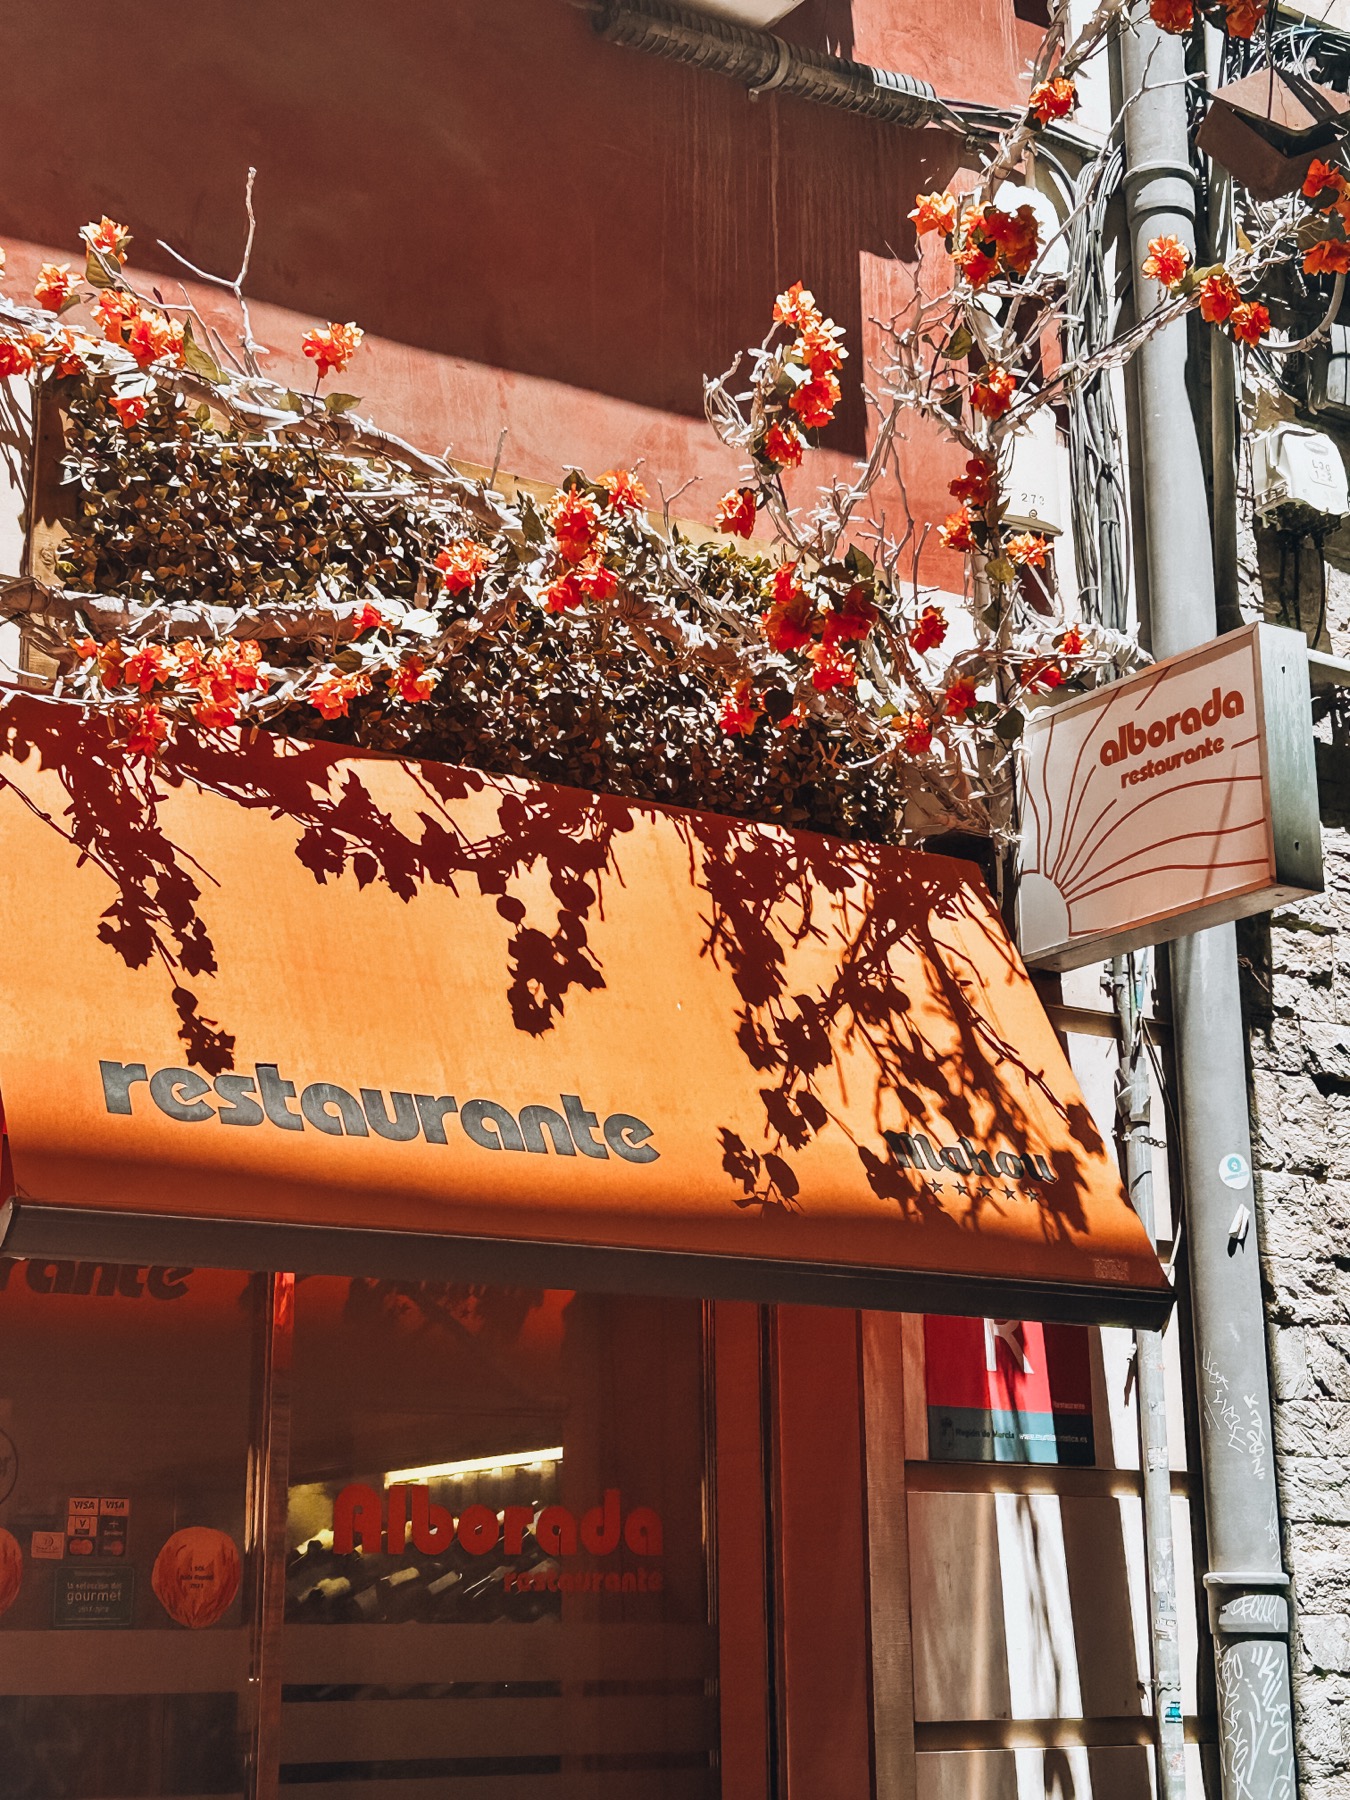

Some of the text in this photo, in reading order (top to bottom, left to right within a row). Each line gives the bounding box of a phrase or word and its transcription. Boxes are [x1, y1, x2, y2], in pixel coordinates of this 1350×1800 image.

[1100, 687, 1244, 767] alborada
[1121, 737, 1225, 789] restaurante
[99, 1060, 661, 1164] restaurante
[884, 1129, 1059, 1184] Mahou
[73, 1500, 95, 1509] VISA
[106, 1500, 124, 1509] VISA
[333, 1483, 663, 1556] Alborada
[67, 1590, 121, 1605] gourmet
[504, 1567, 663, 1593] restaurante
